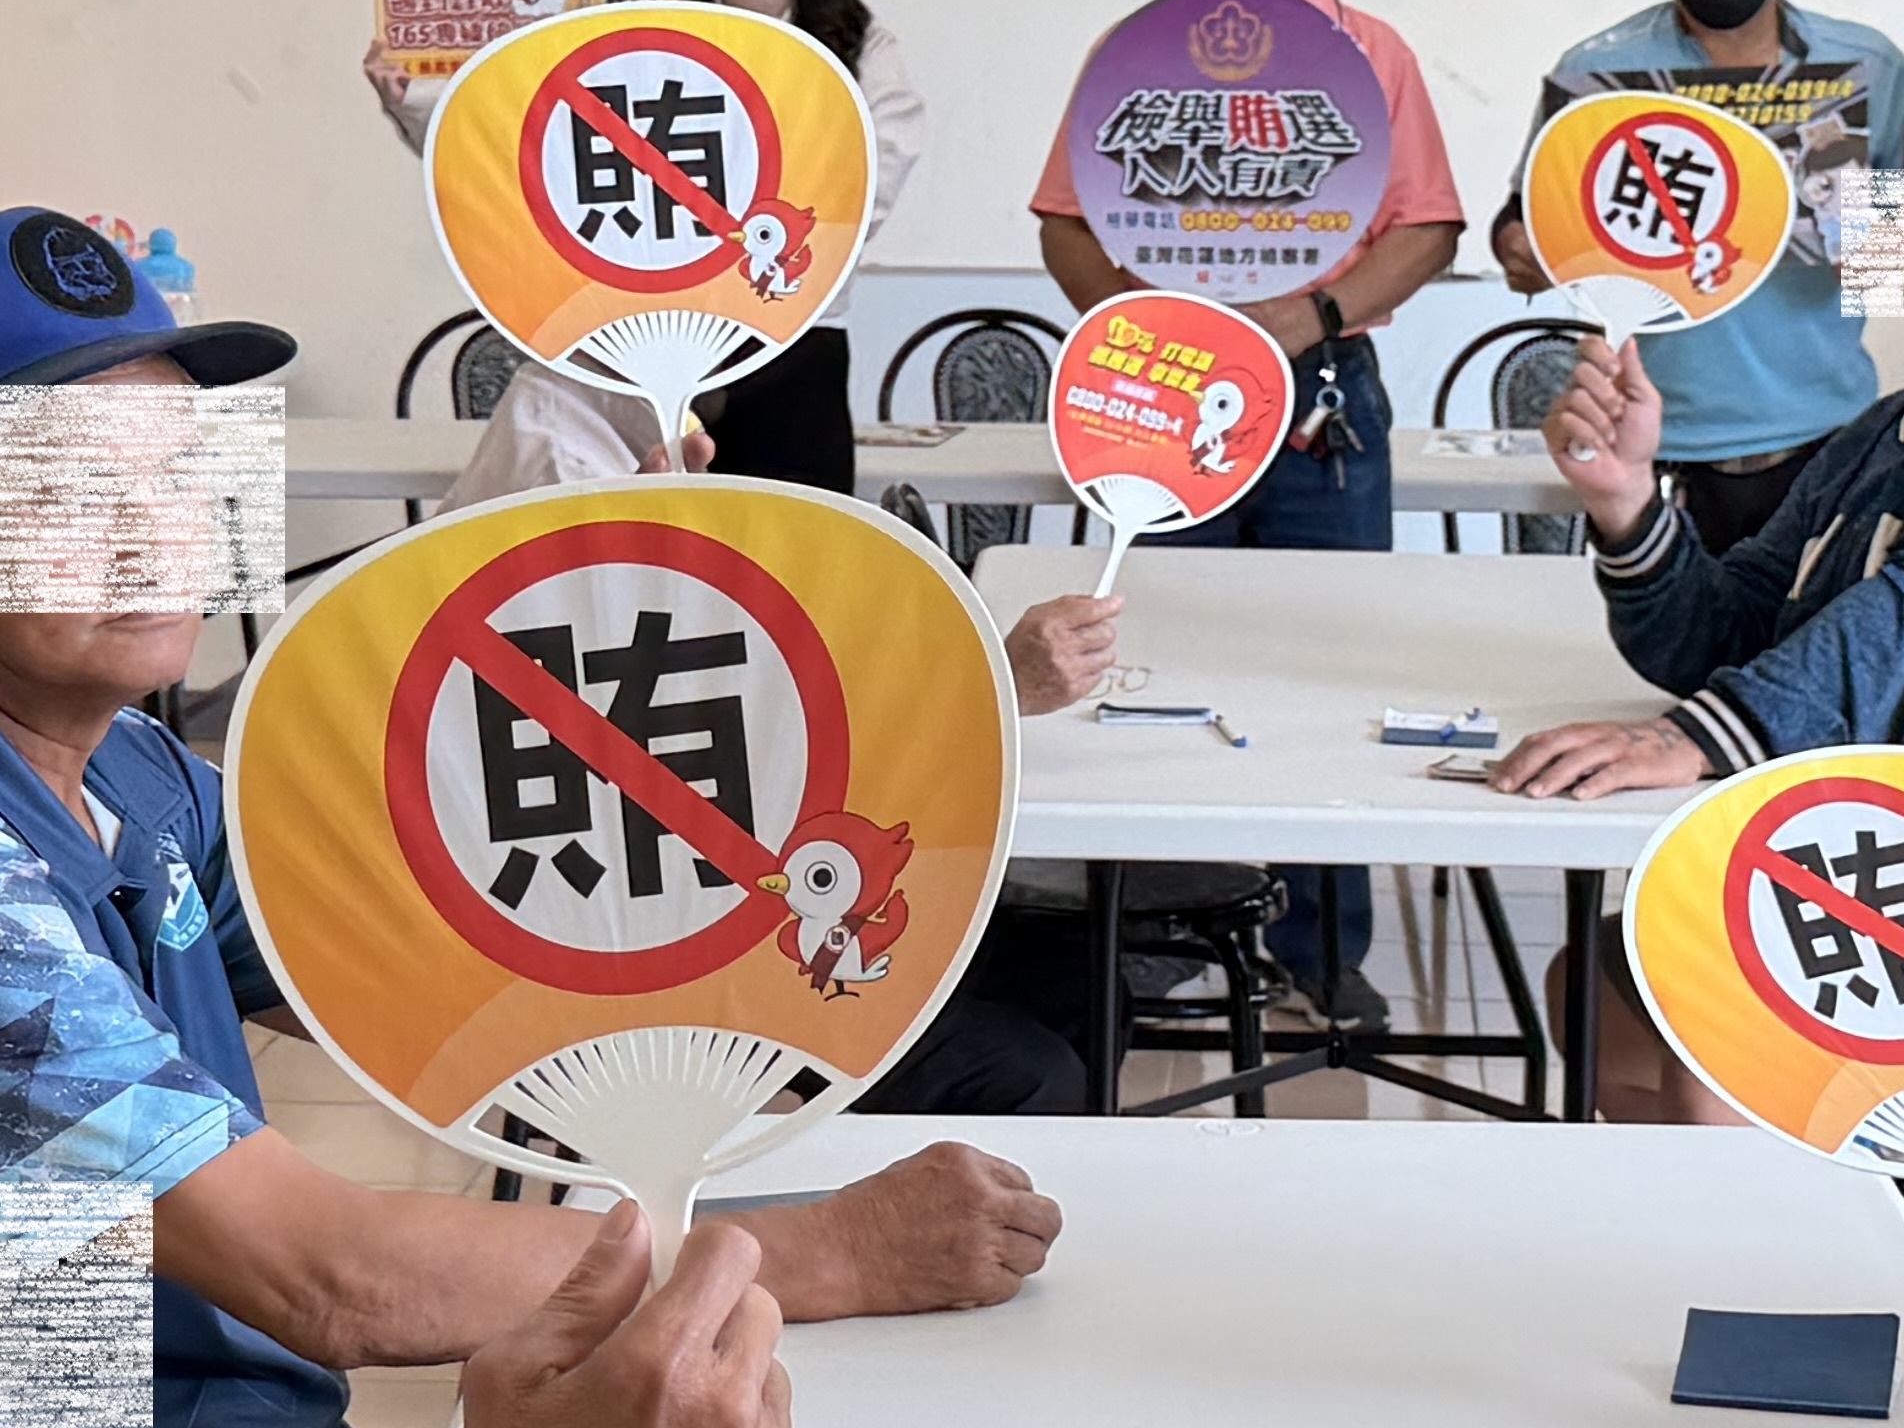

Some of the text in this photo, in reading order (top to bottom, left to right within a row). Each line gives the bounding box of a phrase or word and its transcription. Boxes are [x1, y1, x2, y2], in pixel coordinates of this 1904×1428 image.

[570, 79, 728, 243] 賄
[1096, 90, 1362, 152] 檢舉賄選
[1122, 147, 1333, 197] 人人有責
[1604, 137, 1717, 246] 賄
[472, 609, 757, 911] 賄
